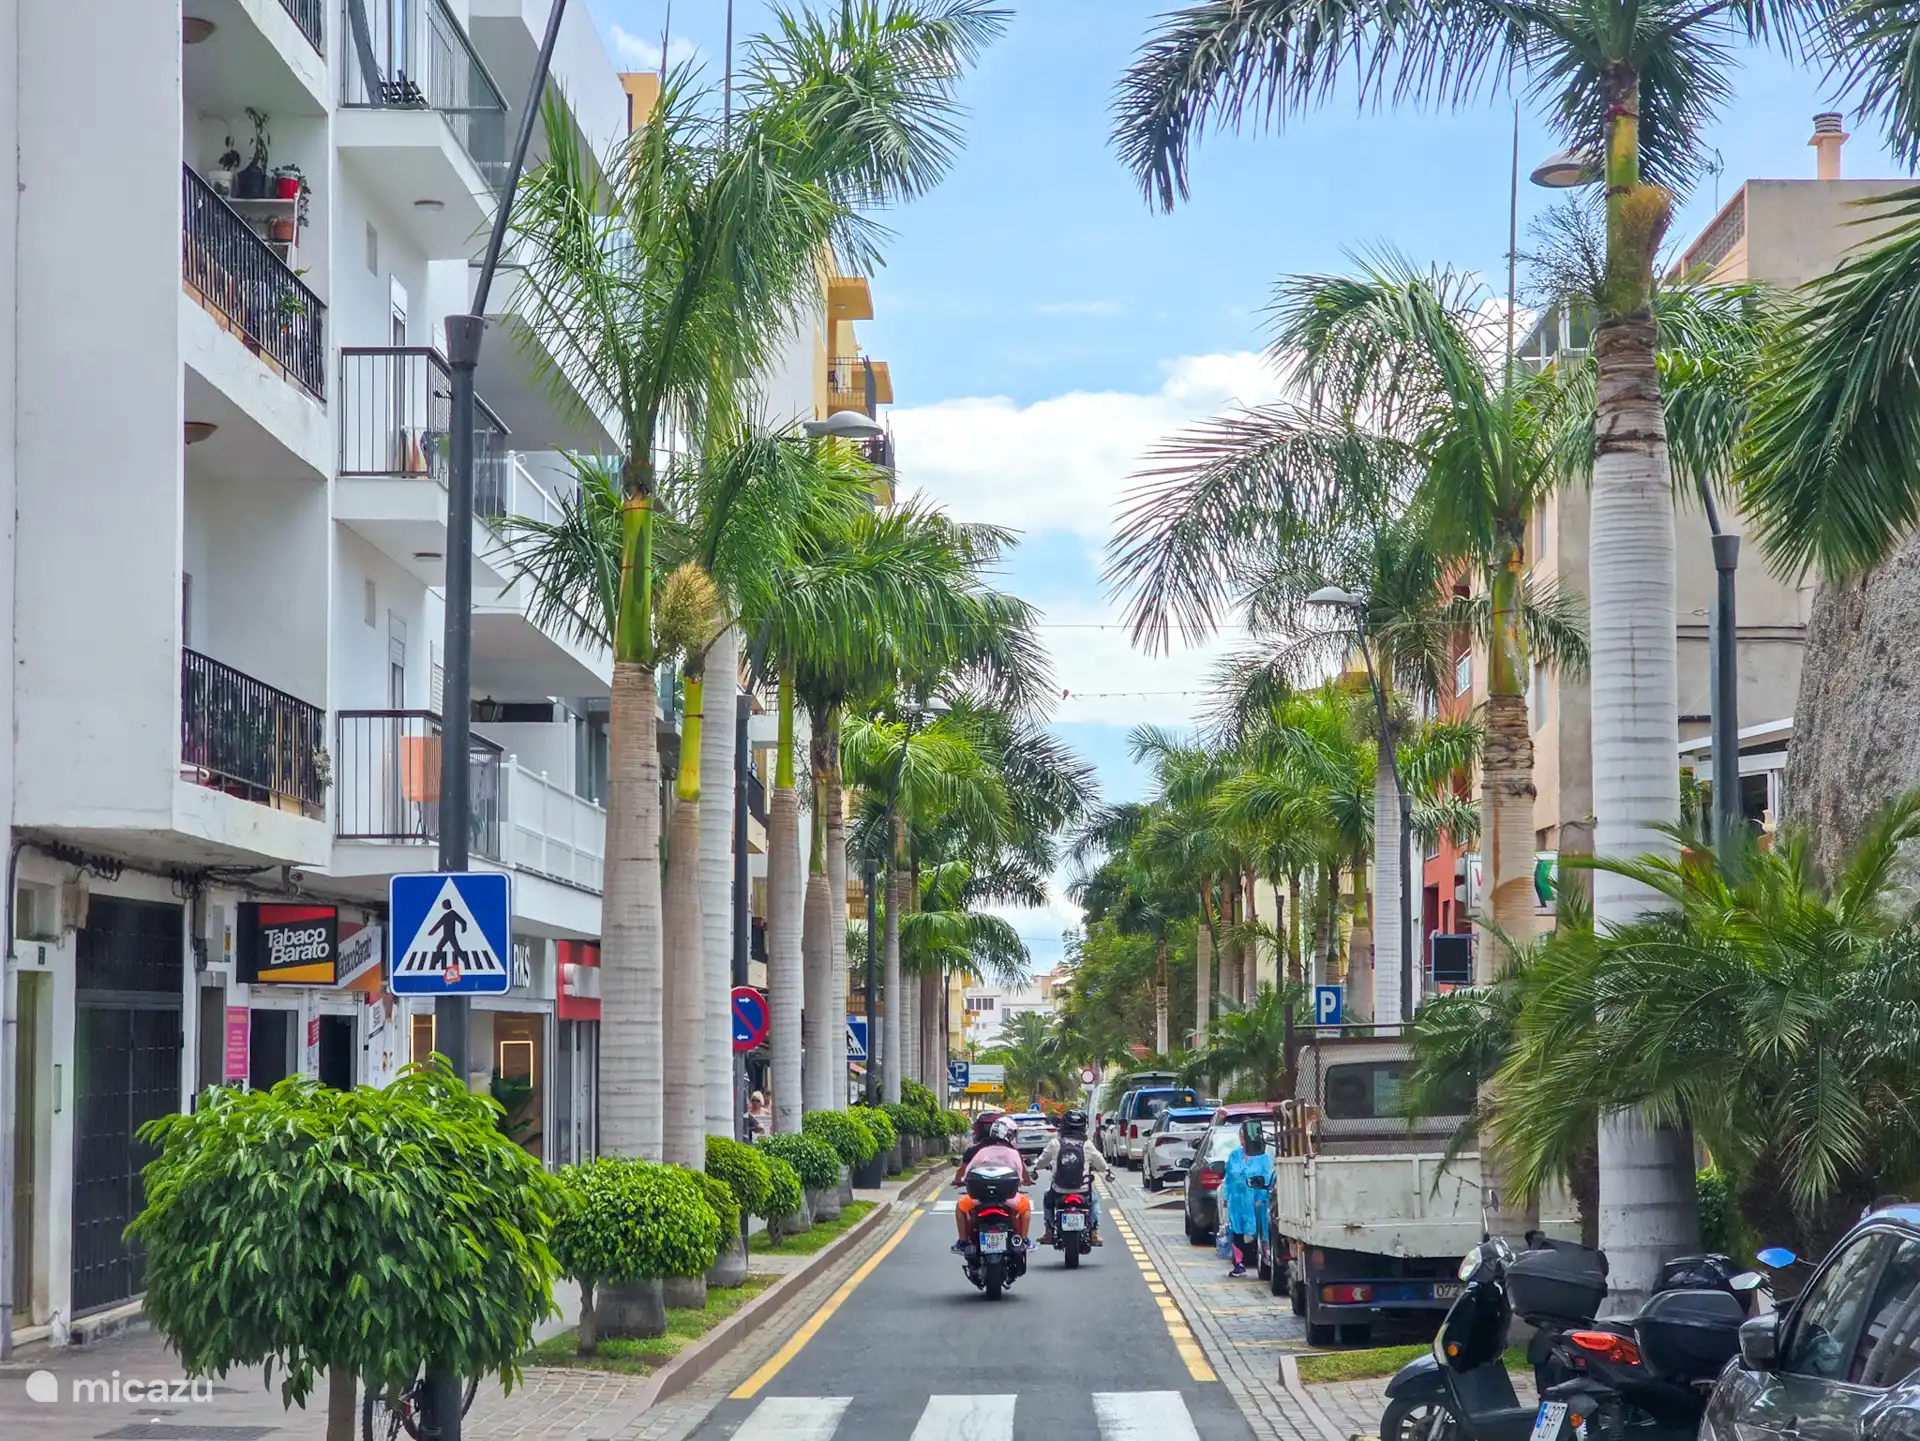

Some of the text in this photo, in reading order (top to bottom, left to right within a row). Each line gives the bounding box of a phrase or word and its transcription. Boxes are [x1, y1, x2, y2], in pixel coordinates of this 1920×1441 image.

[264, 927, 326, 949] Tabaco
[270, 941, 330, 965] Barato
[513, 944, 531, 988] RKS
[1320, 991, 1337, 1023] P
[955, 1062, 967, 1078] P
